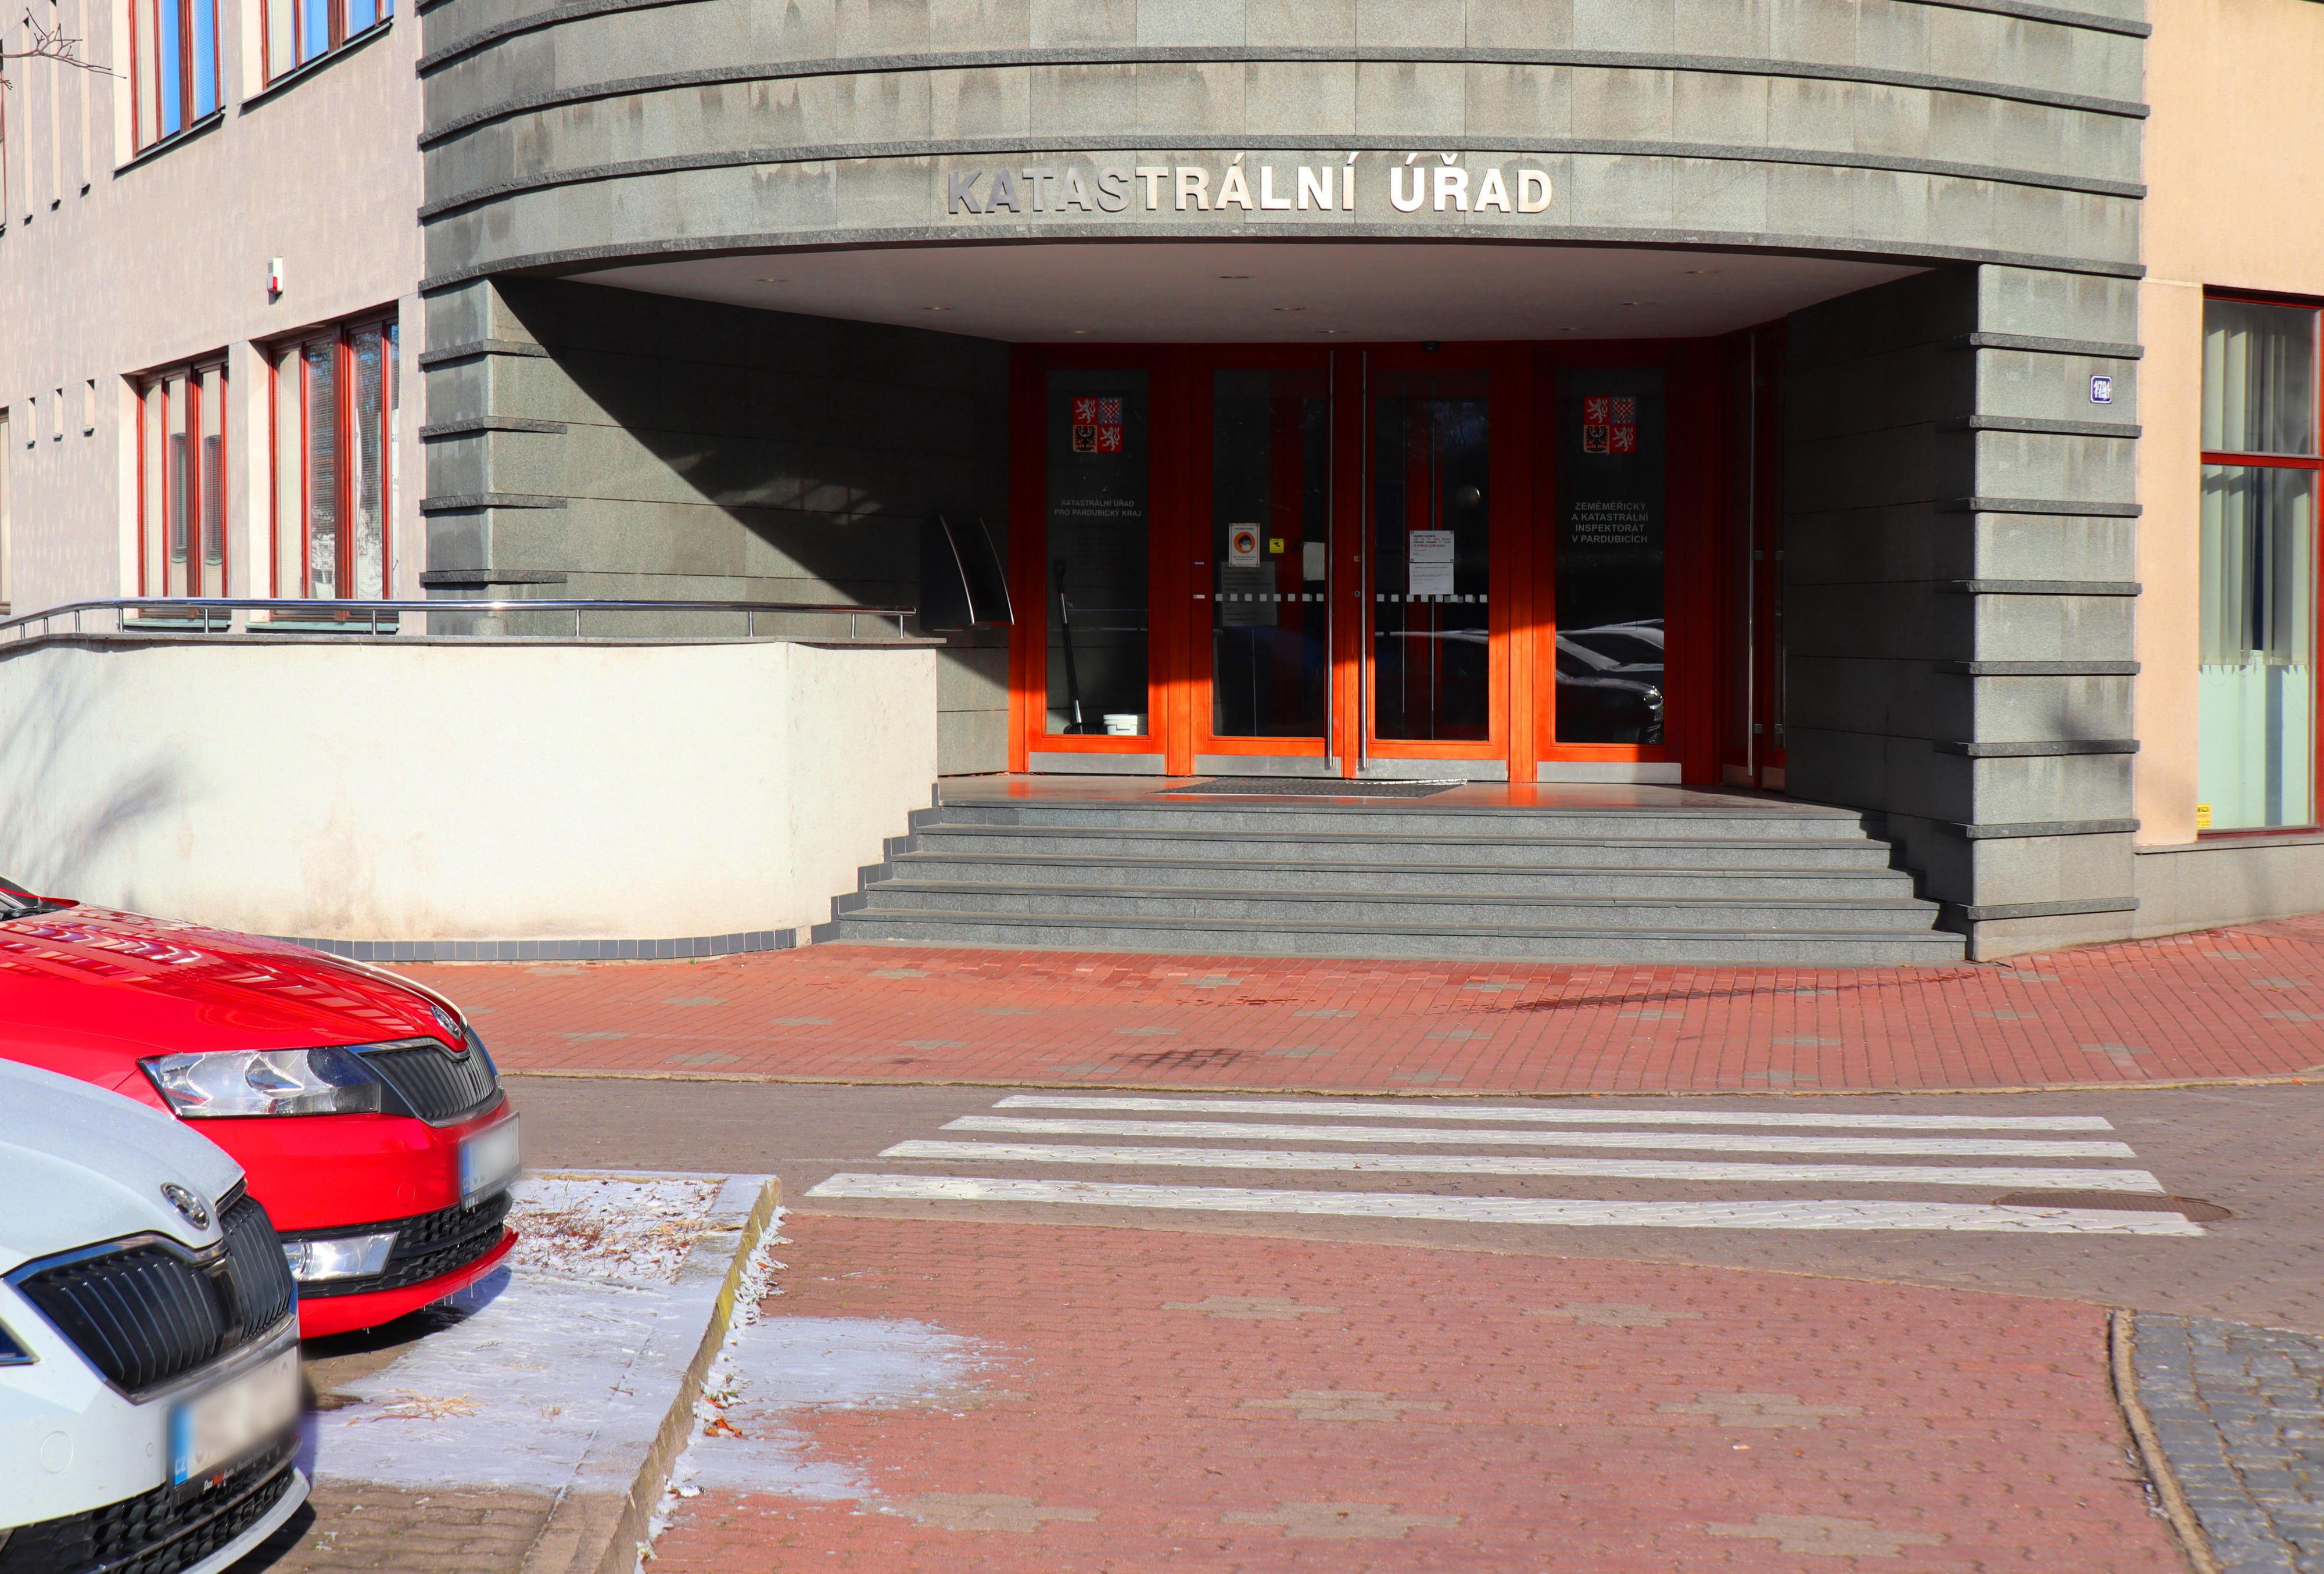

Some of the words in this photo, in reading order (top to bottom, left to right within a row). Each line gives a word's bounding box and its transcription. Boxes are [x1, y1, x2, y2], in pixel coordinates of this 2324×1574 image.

[948, 152, 1360, 214] KATASTRÁLNÍ
[1389, 152, 1553, 213] ÚŘAD
[1061, 499, 1111, 507] KATASTRÁLNÍ
[1114, 499, 1134, 507] ÚŘAD
[1575, 500, 1647, 510] ZEMĚMĚŘICKÝ
[1073, 508, 1119, 516] PARDUBICKÝ
[1581, 511, 1648, 521] KATASTRÁLNÍ
[1576, 522, 1644, 532] INSPEKTORÁT
[1581, 533, 1648, 543] PARDUBICÍCH
[175, 1456, 187, 1475] CZ
